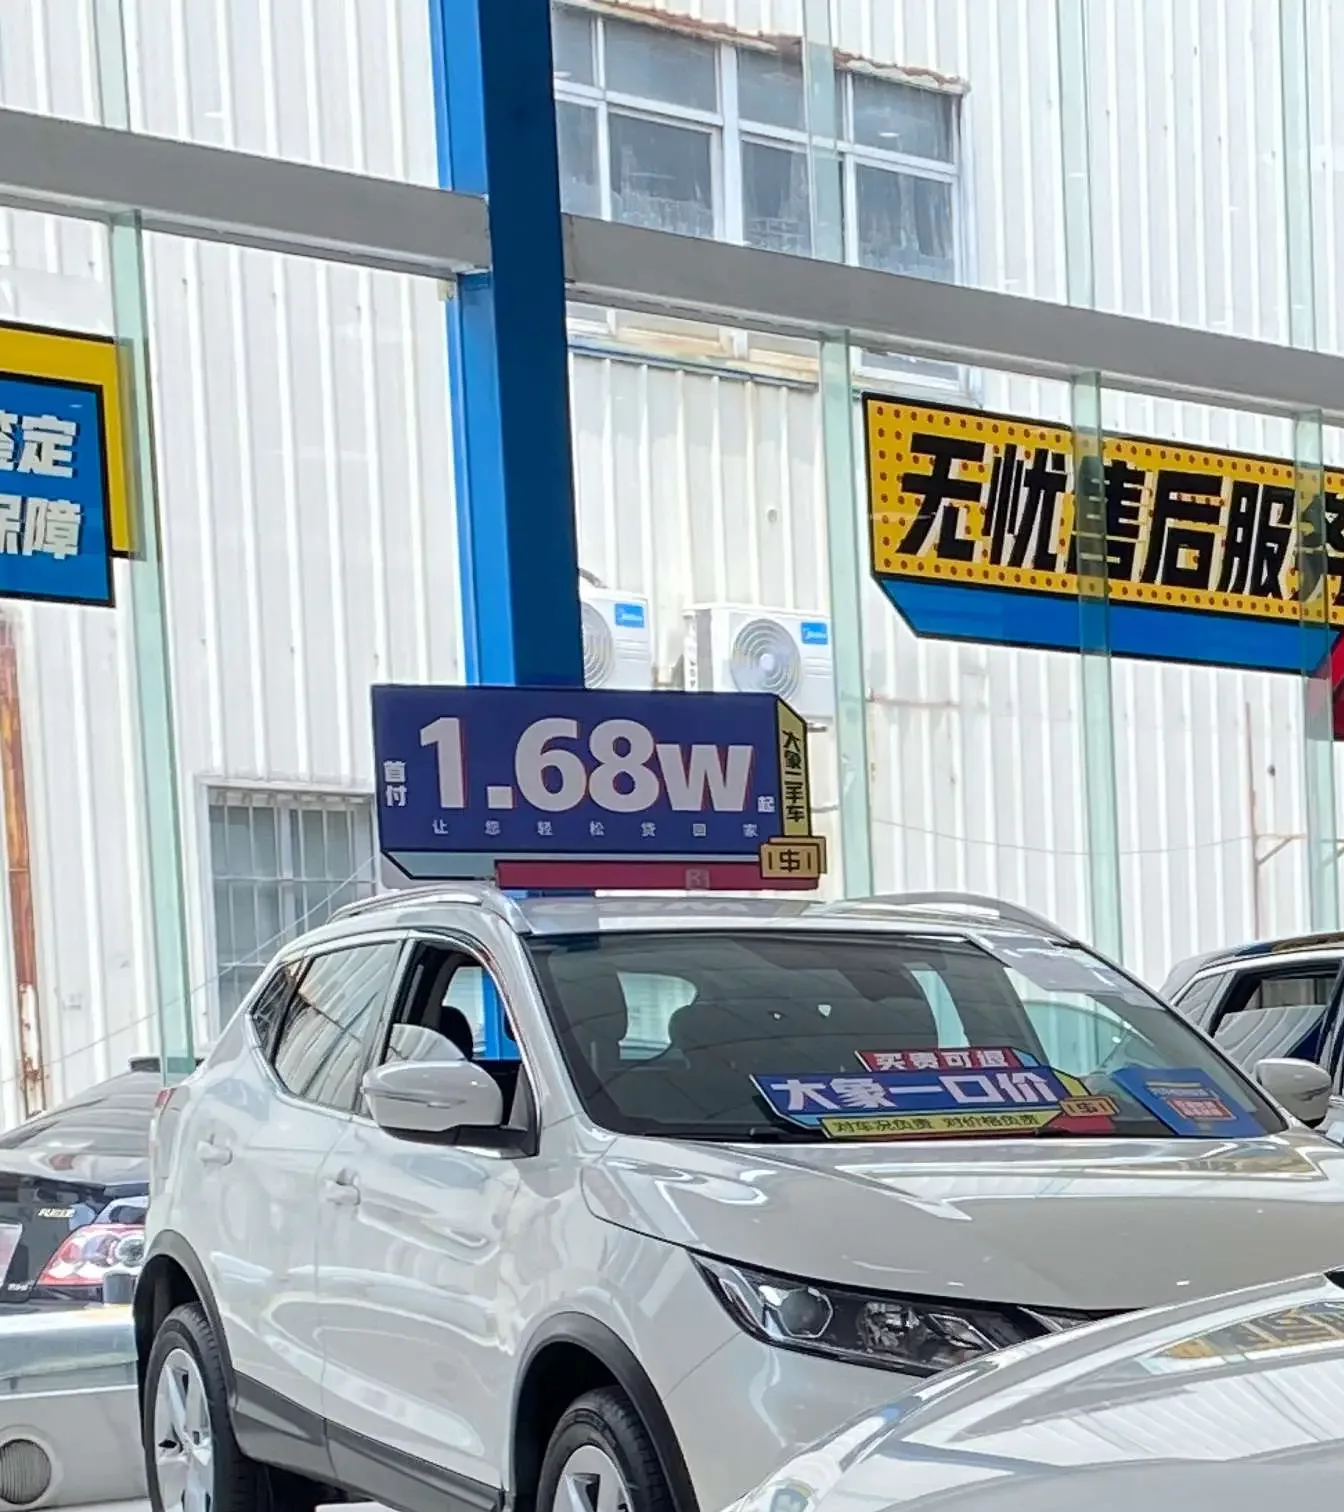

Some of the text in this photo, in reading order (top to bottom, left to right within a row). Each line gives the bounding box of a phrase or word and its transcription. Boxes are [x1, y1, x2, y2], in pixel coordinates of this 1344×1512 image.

[383, 760, 408, 807] 首付
[770, 1071, 1059, 1111] 大象一口价
